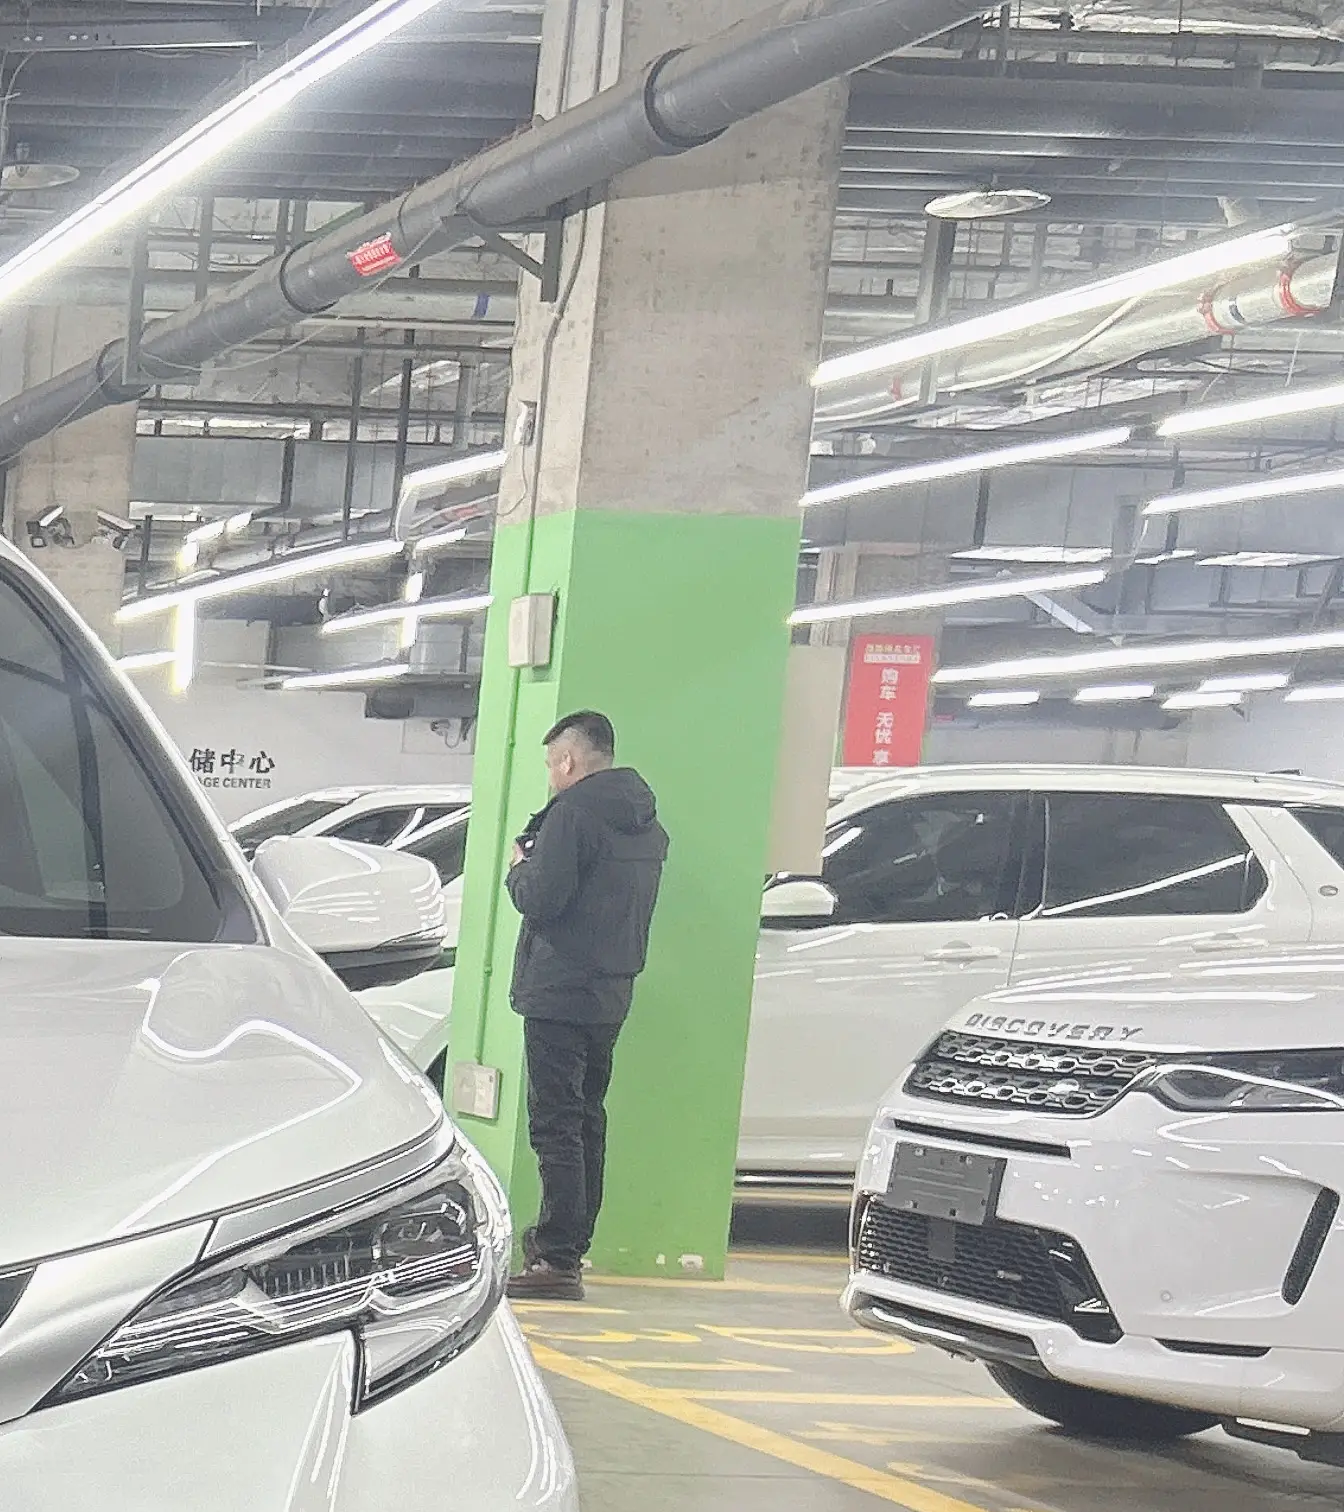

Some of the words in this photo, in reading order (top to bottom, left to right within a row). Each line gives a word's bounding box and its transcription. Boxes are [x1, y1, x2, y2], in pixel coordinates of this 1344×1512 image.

[188, 748, 276, 774] 储中心
[222, 777, 272, 789] CENTER
[964, 1012, 1144, 1042] DISCOVERY
